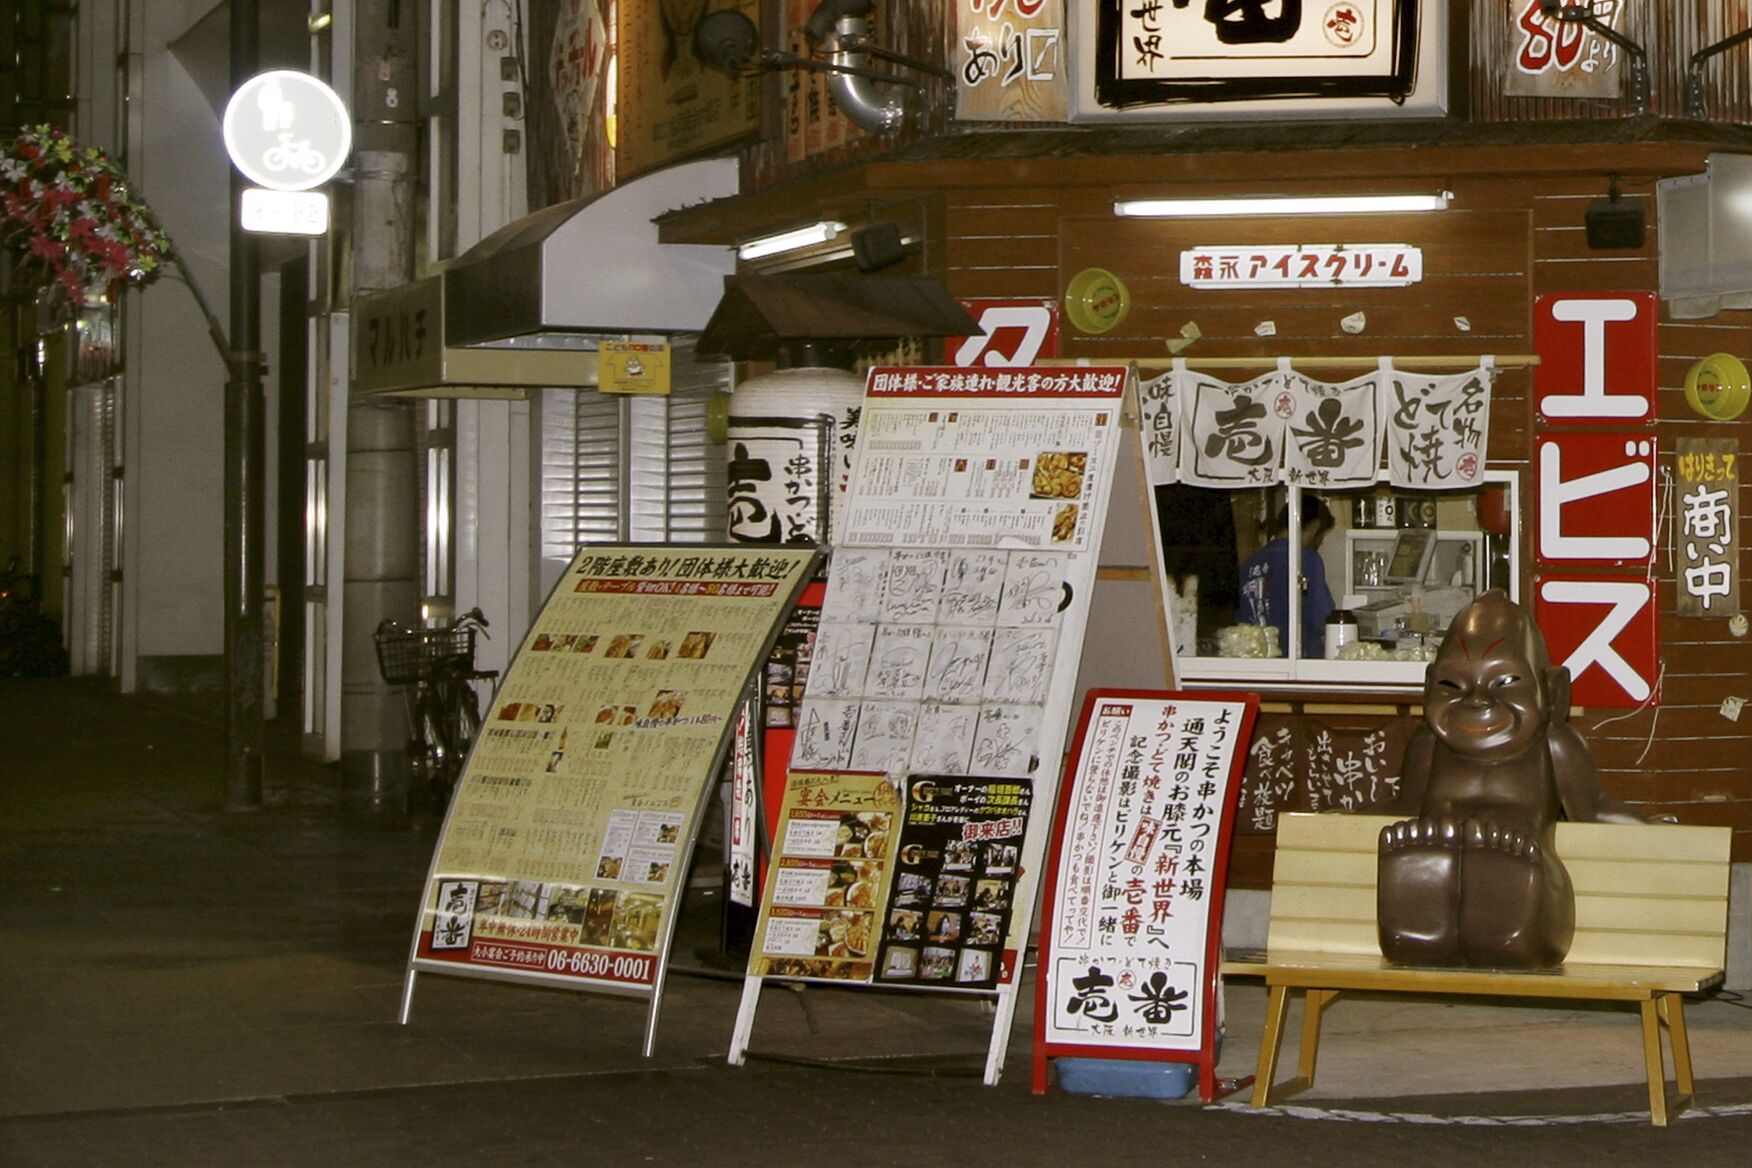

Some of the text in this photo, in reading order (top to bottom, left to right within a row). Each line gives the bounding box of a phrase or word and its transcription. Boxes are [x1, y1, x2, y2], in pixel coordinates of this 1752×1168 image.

[1192, 253, 1410, 281] 森永 アイスクリーム
[1148, 376, 1176, 459] 味自慢
[1204, 394, 1365, 468] 壱番
[1393, 380, 1454, 483] どて焼
[1453, 377, 1484, 450] 名物
[1539, 299, 1651, 703] エビス
[1677, 452, 1736, 482] はりきって
[1682, 484, 1733, 610] 商い中
[1178, 707, 1232, 902] ようこそ串かつの本場
[439, 882, 468, 946] 壱番
[548, 949, 650, 980] 06-6630-0001
[1065, 965, 1189, 1024] 壱番
